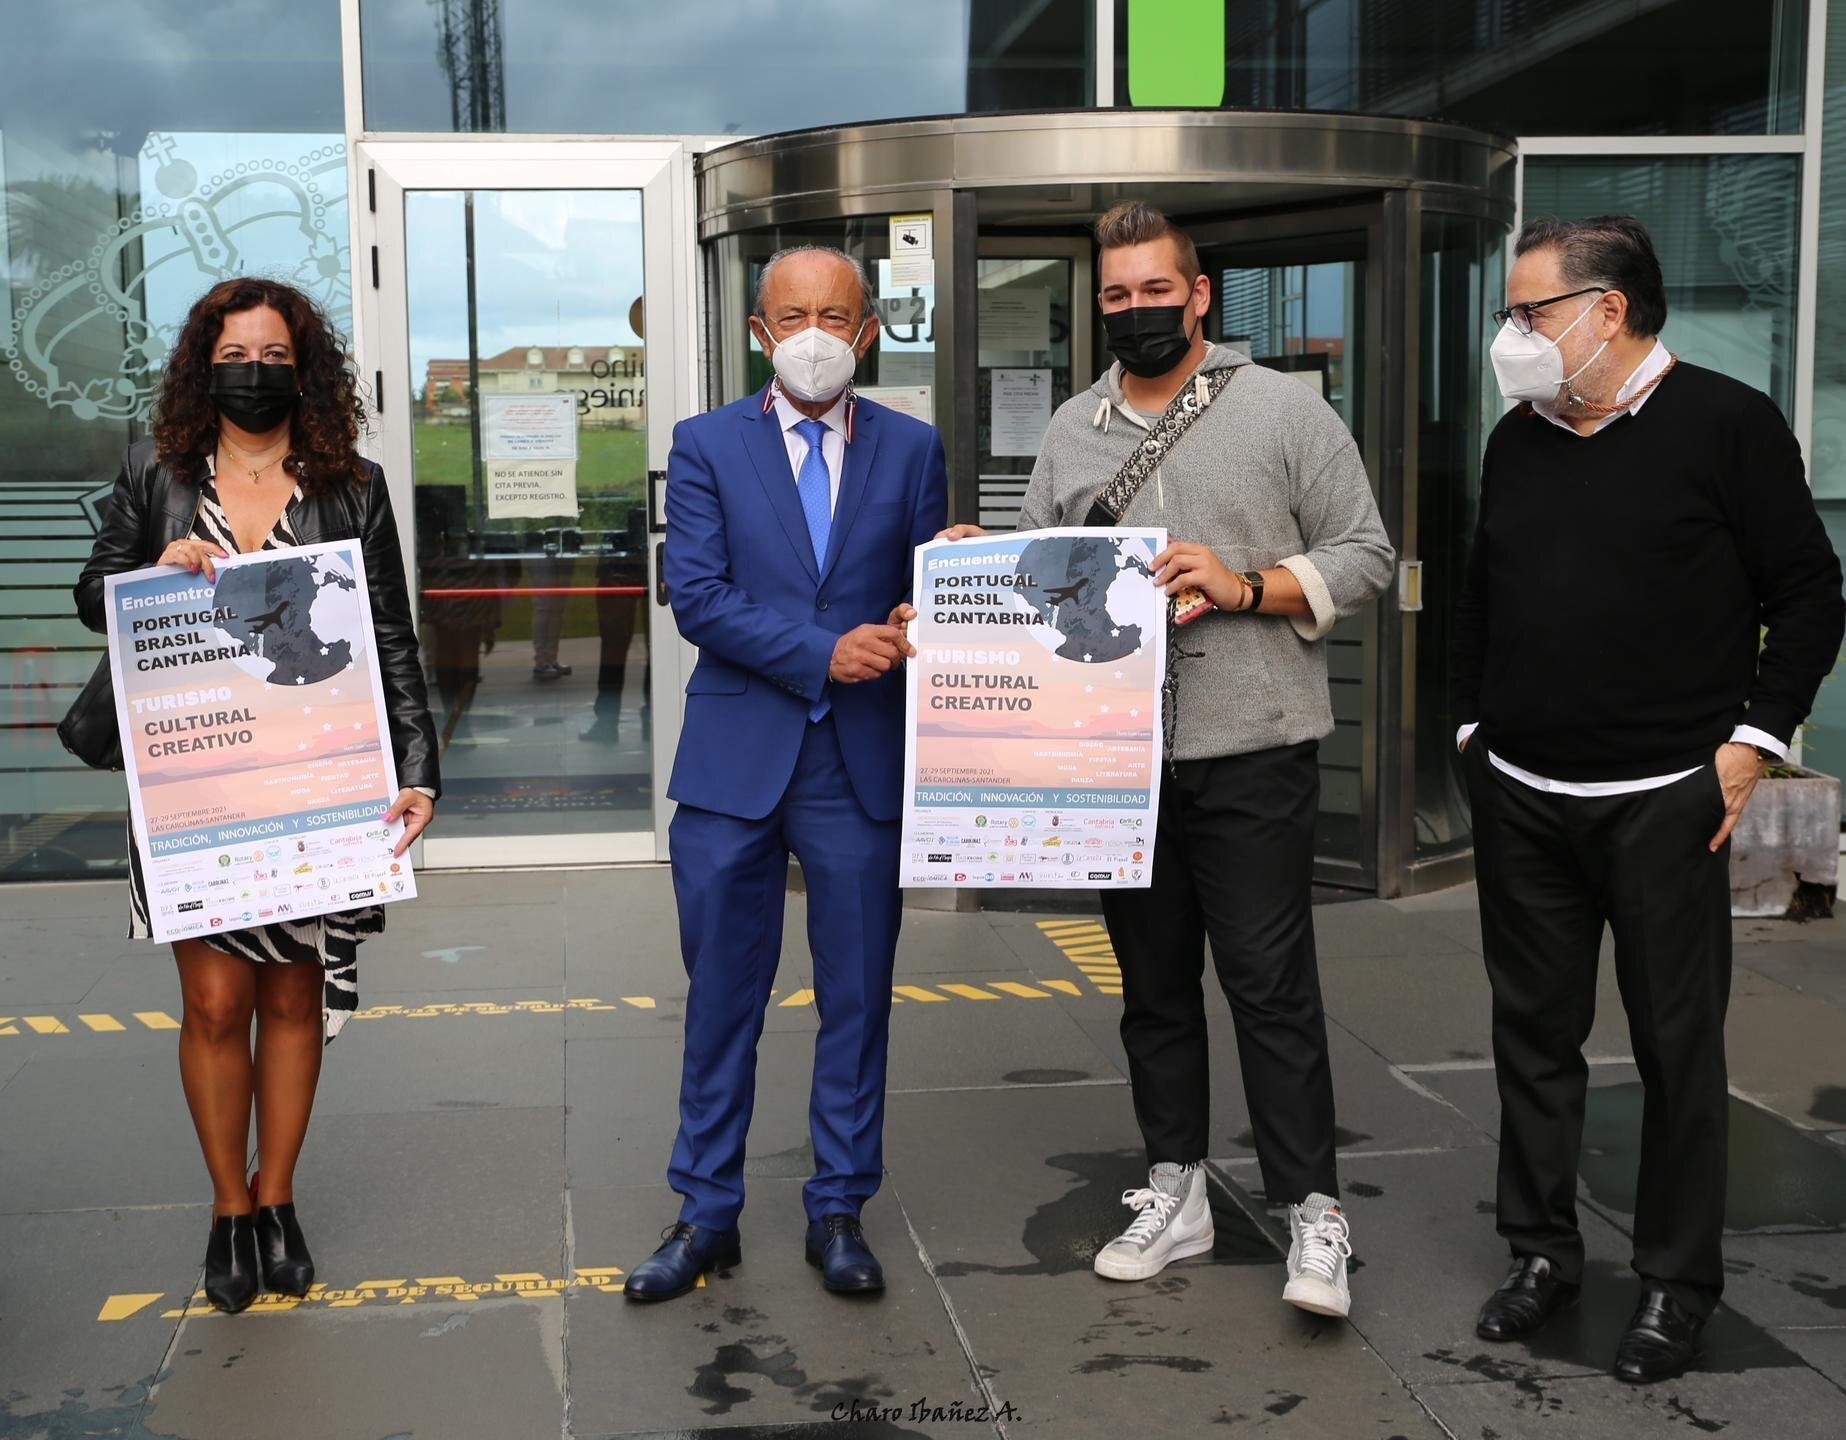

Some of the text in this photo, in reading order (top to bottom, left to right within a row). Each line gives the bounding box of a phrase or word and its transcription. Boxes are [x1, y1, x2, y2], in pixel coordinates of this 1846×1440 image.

[909, 296, 925, 324] 2
[518, 470, 548, 478] ATIENDE
[513, 481, 541, 489] PREVIA.
[529, 492, 568, 501] REGISTRO.
[927, 553, 1019, 571] Encuentro
[934, 574, 1038, 588] PORTUGAL
[121, 587, 215, 611] Encuentro
[934, 593, 1003, 605] BRASIL
[132, 606, 238, 633] PORTUGAL
[933, 612, 1045, 625] CANTABRIA
[134, 632, 206, 653] BRASIL
[137, 645, 251, 671] CANTABRIA
[923, 649, 1020, 666] TURISMO
[931, 673, 1039, 690] CULTURAL
[132, 686, 232, 714] TURISMO
[930, 695, 1032, 712] CREATIVO
[144, 707, 257, 736] CULTURAL
[148, 729, 253, 758] CREATIVO
[361, 772, 379, 780] ARTE
[330, 783, 373, 794] LITERATURA
[916, 790, 1146, 804] TRADICIÓN, INNOVACIÓN Y SOSTENIBILIDAD
[169, 807, 210, 821] SEPTIEMBRE
[211, 805, 227, 814] 2021
[150, 804, 388, 852] TRADICIÓN, INNOVACIÓN Y SOSTENIBILIDAD
[151, 824, 165, 833] LAS
[1083, 818, 1115, 826] Cantabria
[329, 835, 362, 845] Cantabria
[384, 1286, 428, 1298] DE
[433, 1276, 611, 1295] SEGURIDAD
